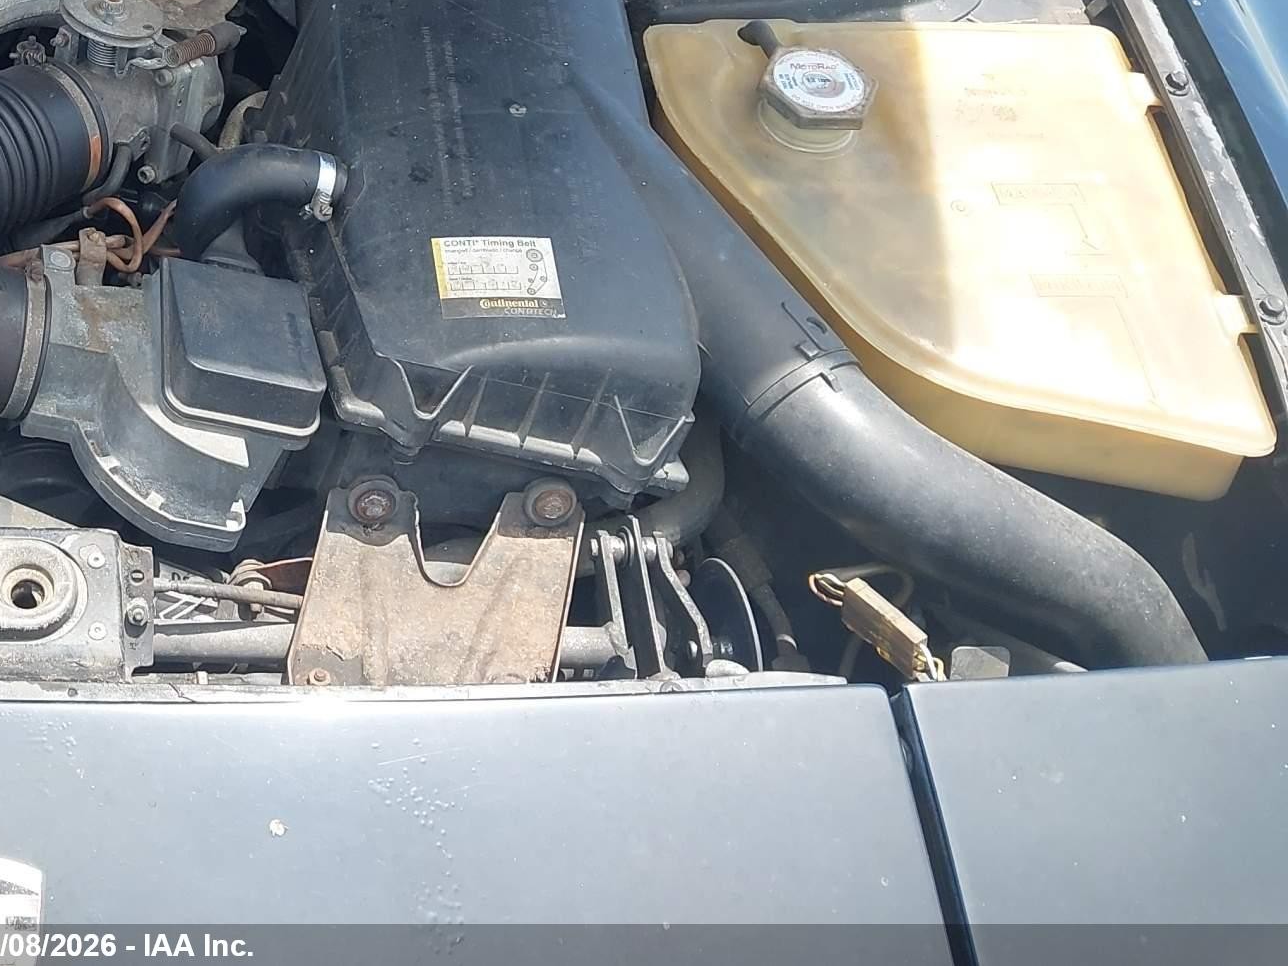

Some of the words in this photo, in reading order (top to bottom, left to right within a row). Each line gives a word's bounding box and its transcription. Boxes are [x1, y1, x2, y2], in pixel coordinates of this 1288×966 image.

[481, 239, 514, 248] Timing
[516, 240, 537, 248] Belt
[479, 299, 539, 309] Continental
